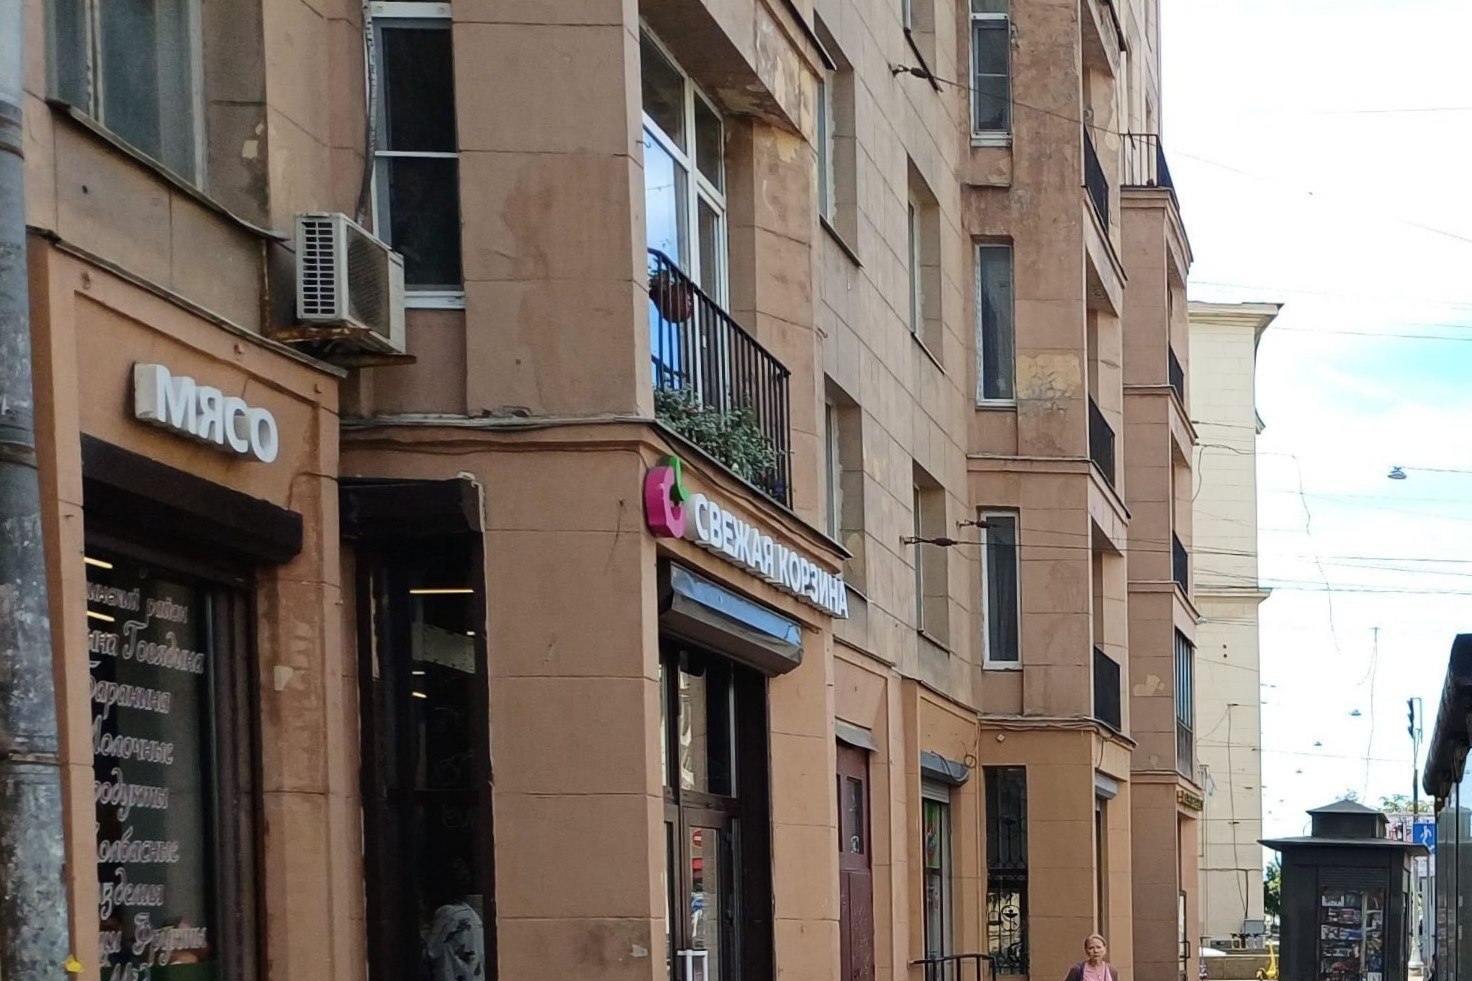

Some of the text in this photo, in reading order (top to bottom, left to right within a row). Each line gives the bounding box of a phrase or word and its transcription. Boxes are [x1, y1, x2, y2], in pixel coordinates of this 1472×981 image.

[138, 363, 279, 464] МЯСО
[693, 493, 849, 619] СВЕЖАЯ КОРЗИНА
